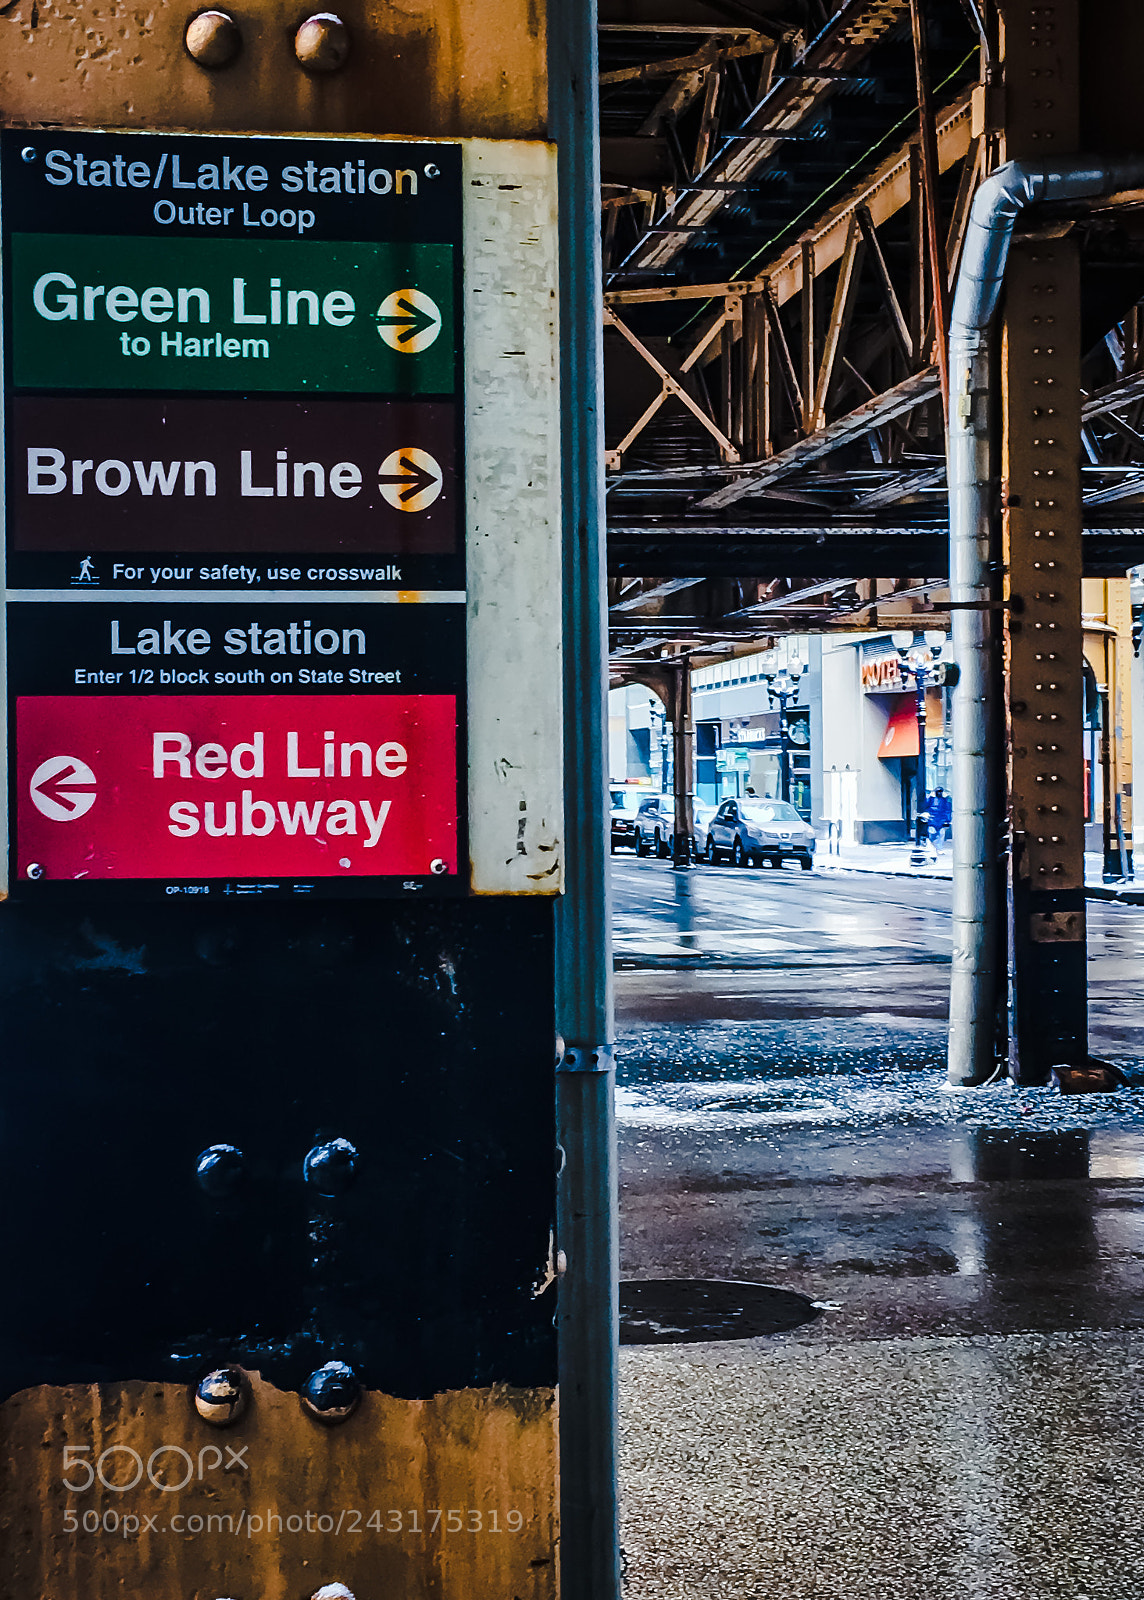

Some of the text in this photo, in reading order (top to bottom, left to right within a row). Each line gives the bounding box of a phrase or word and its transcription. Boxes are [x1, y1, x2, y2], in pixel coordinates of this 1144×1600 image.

[44, 149, 418, 195] State/Lake station
[153, 199, 315, 234] Outer Loop
[32, 272, 355, 327] Green Line
[120, 331, 269, 358] to Harlem
[27, 447, 363, 499] Brown Line
[112, 563, 402, 584] For your safety, use crosswalk
[110, 620, 366, 655] Lake station
[74, 668, 402, 684] Enter 1/2 block south on State Street
[152, 730, 408, 778] Red Line
[167, 789, 393, 848] subway
